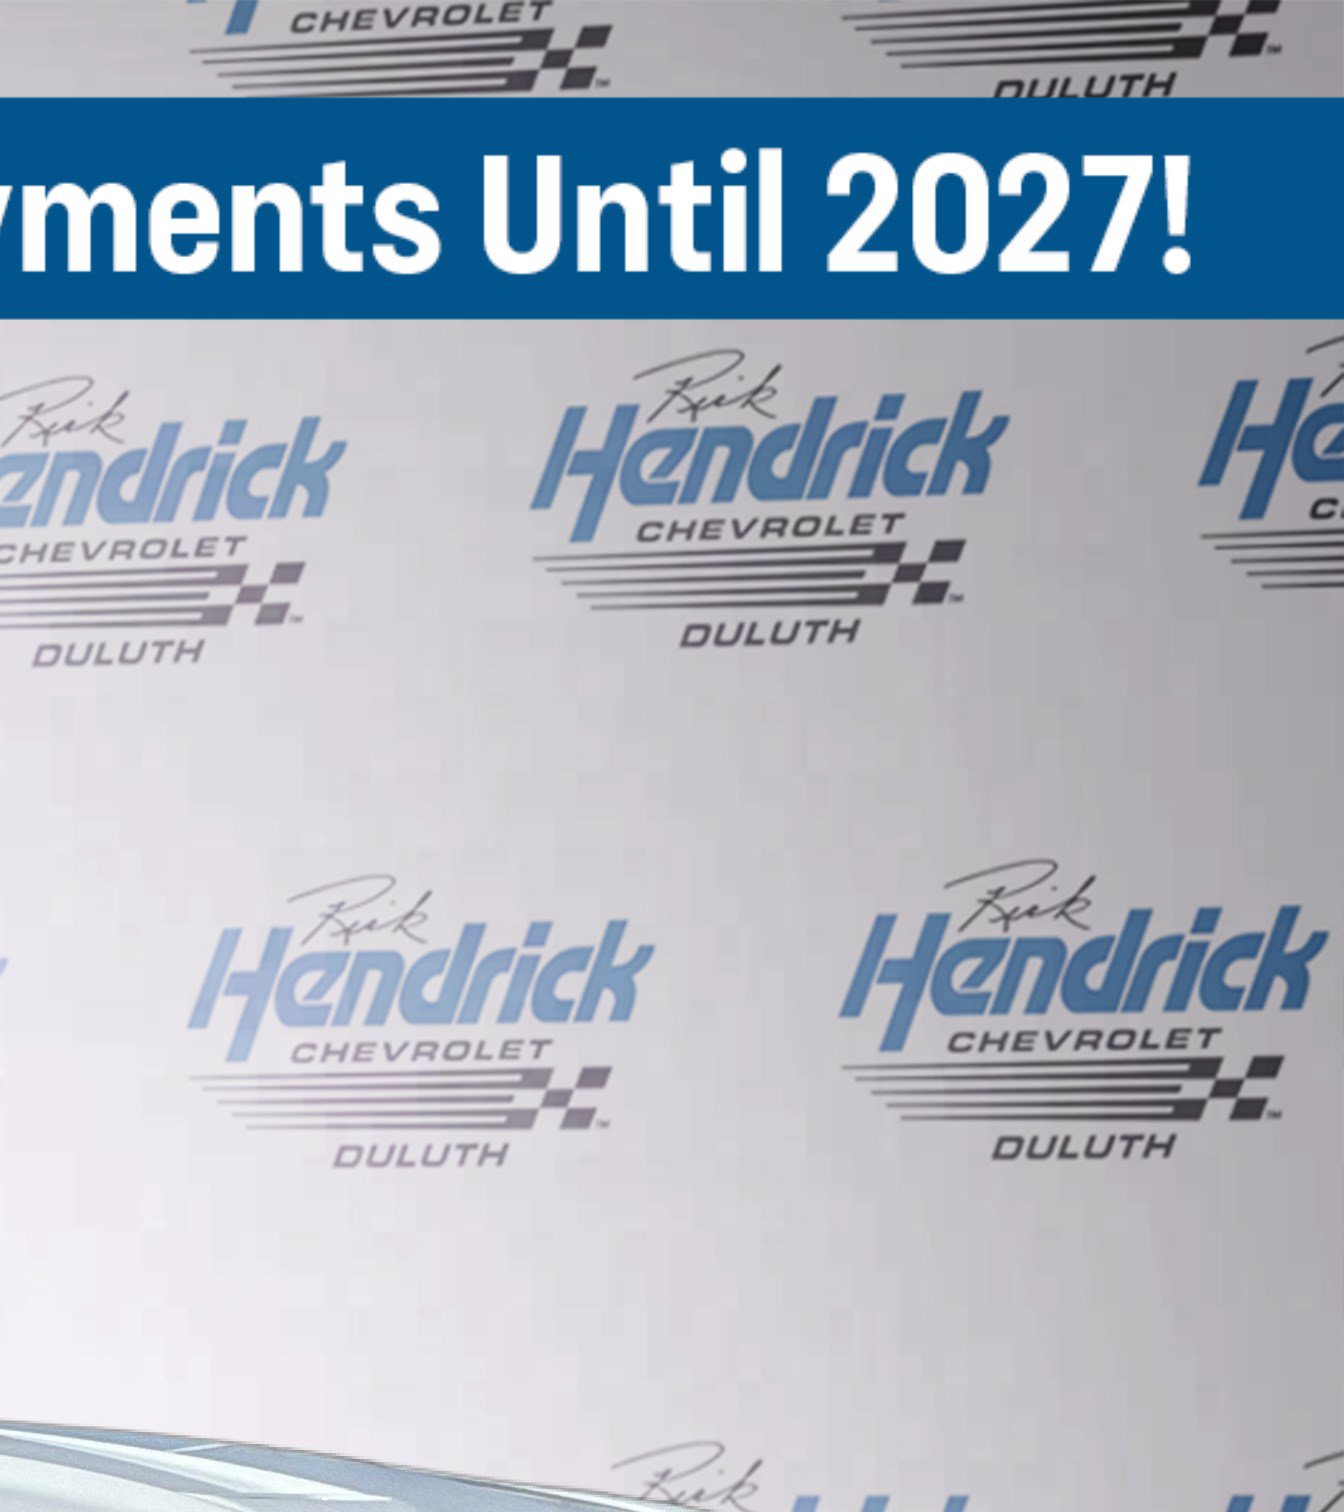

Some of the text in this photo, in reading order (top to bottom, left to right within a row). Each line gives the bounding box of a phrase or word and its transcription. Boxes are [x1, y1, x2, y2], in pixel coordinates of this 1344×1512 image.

[289, 0, 554, 34] CHEVROLET
[529, 388, 1012, 544] Hendrick
[635, 511, 907, 544] CHEVROLET
[678, 617, 862, 650] DULUTH
[31, 638, 206, 668] DULUTH
[186, 917, 656, 1055] Hendrick
[838, 903, 1331, 1055] Hendrick
[290, 1038, 554, 1064] CHEVROLET
[946, 1026, 1224, 1054] CHEVROLET
[332, 1142, 510, 1169] DULUTH
[990, 1132, 1178, 1162] DULUTH
